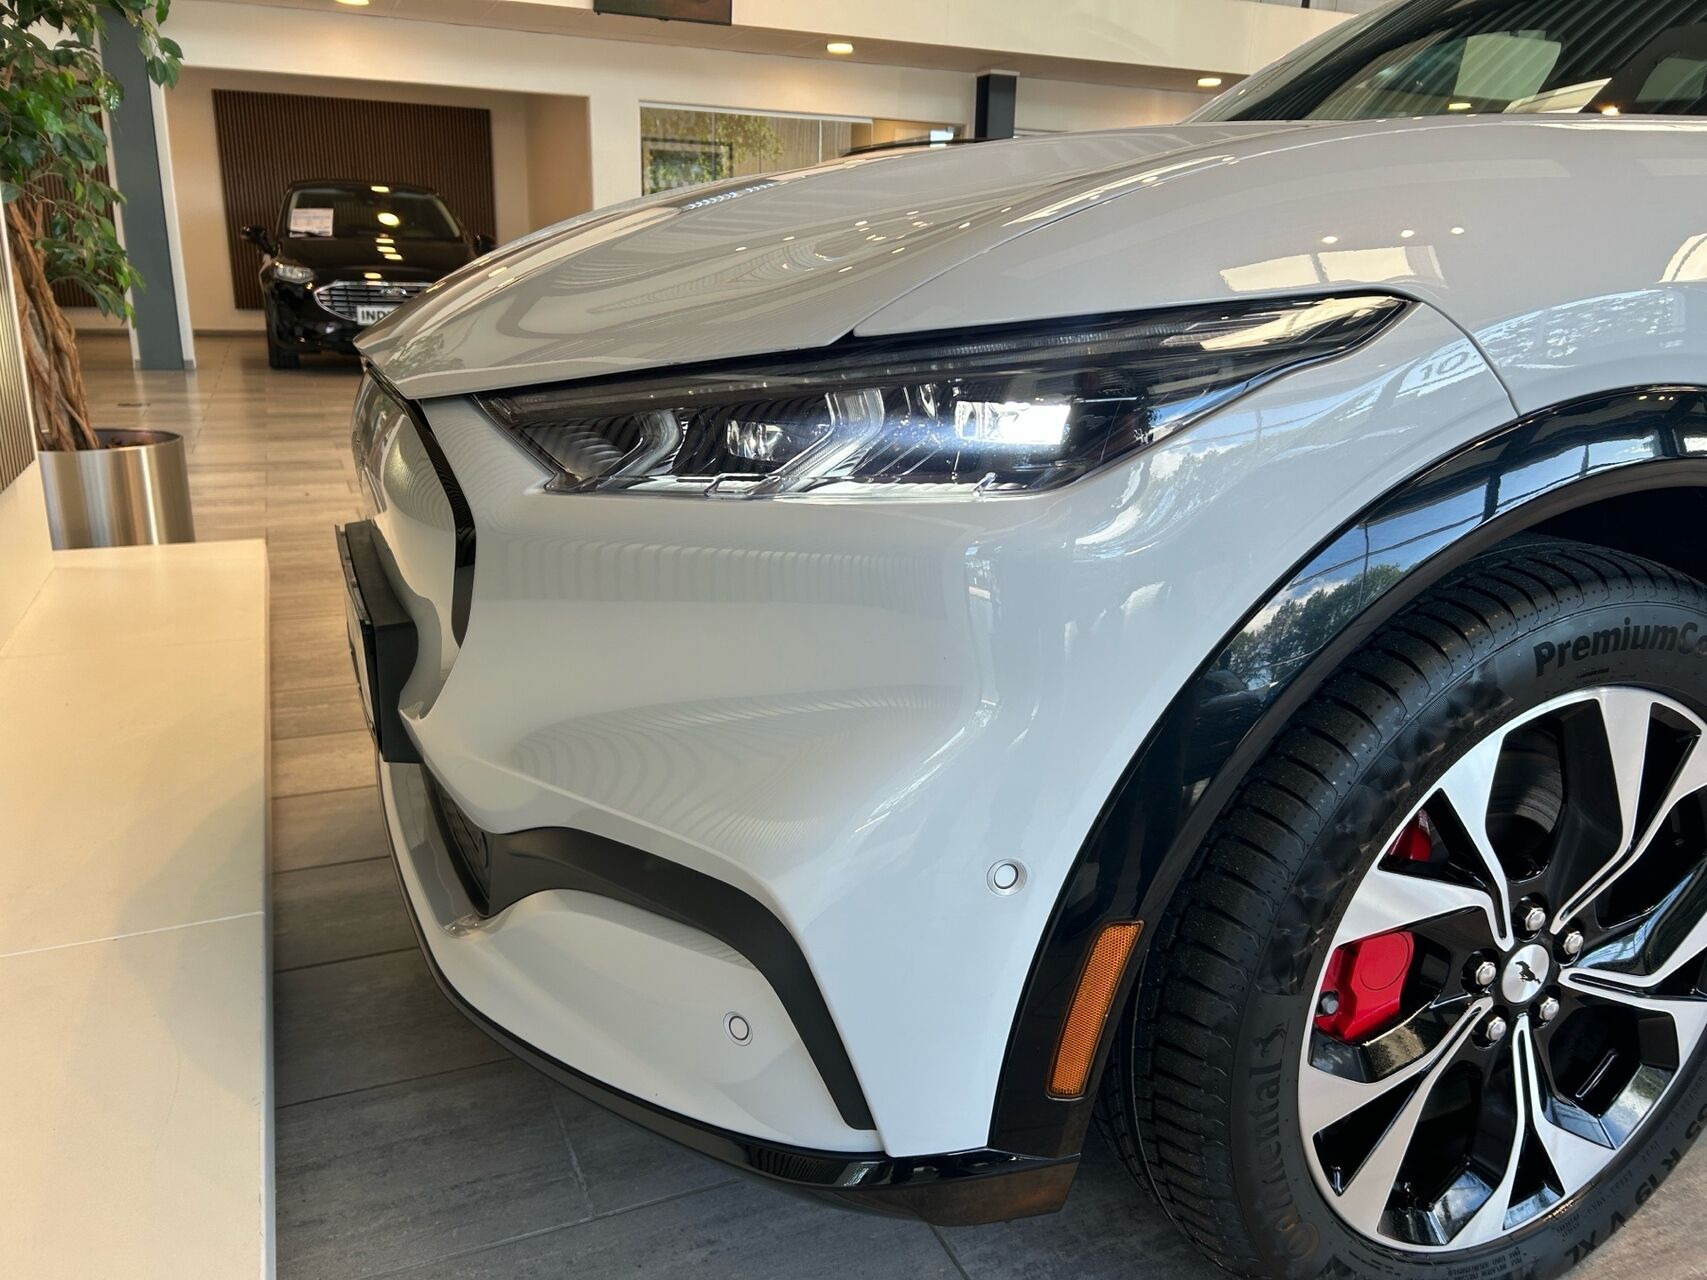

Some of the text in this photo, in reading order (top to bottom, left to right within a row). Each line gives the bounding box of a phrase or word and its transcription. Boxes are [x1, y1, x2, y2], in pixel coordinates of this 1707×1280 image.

[361, 310, 391, 321] IND
[1661, 1147, 1682, 1172] R
[1635, 1174, 1660, 1205] 19
